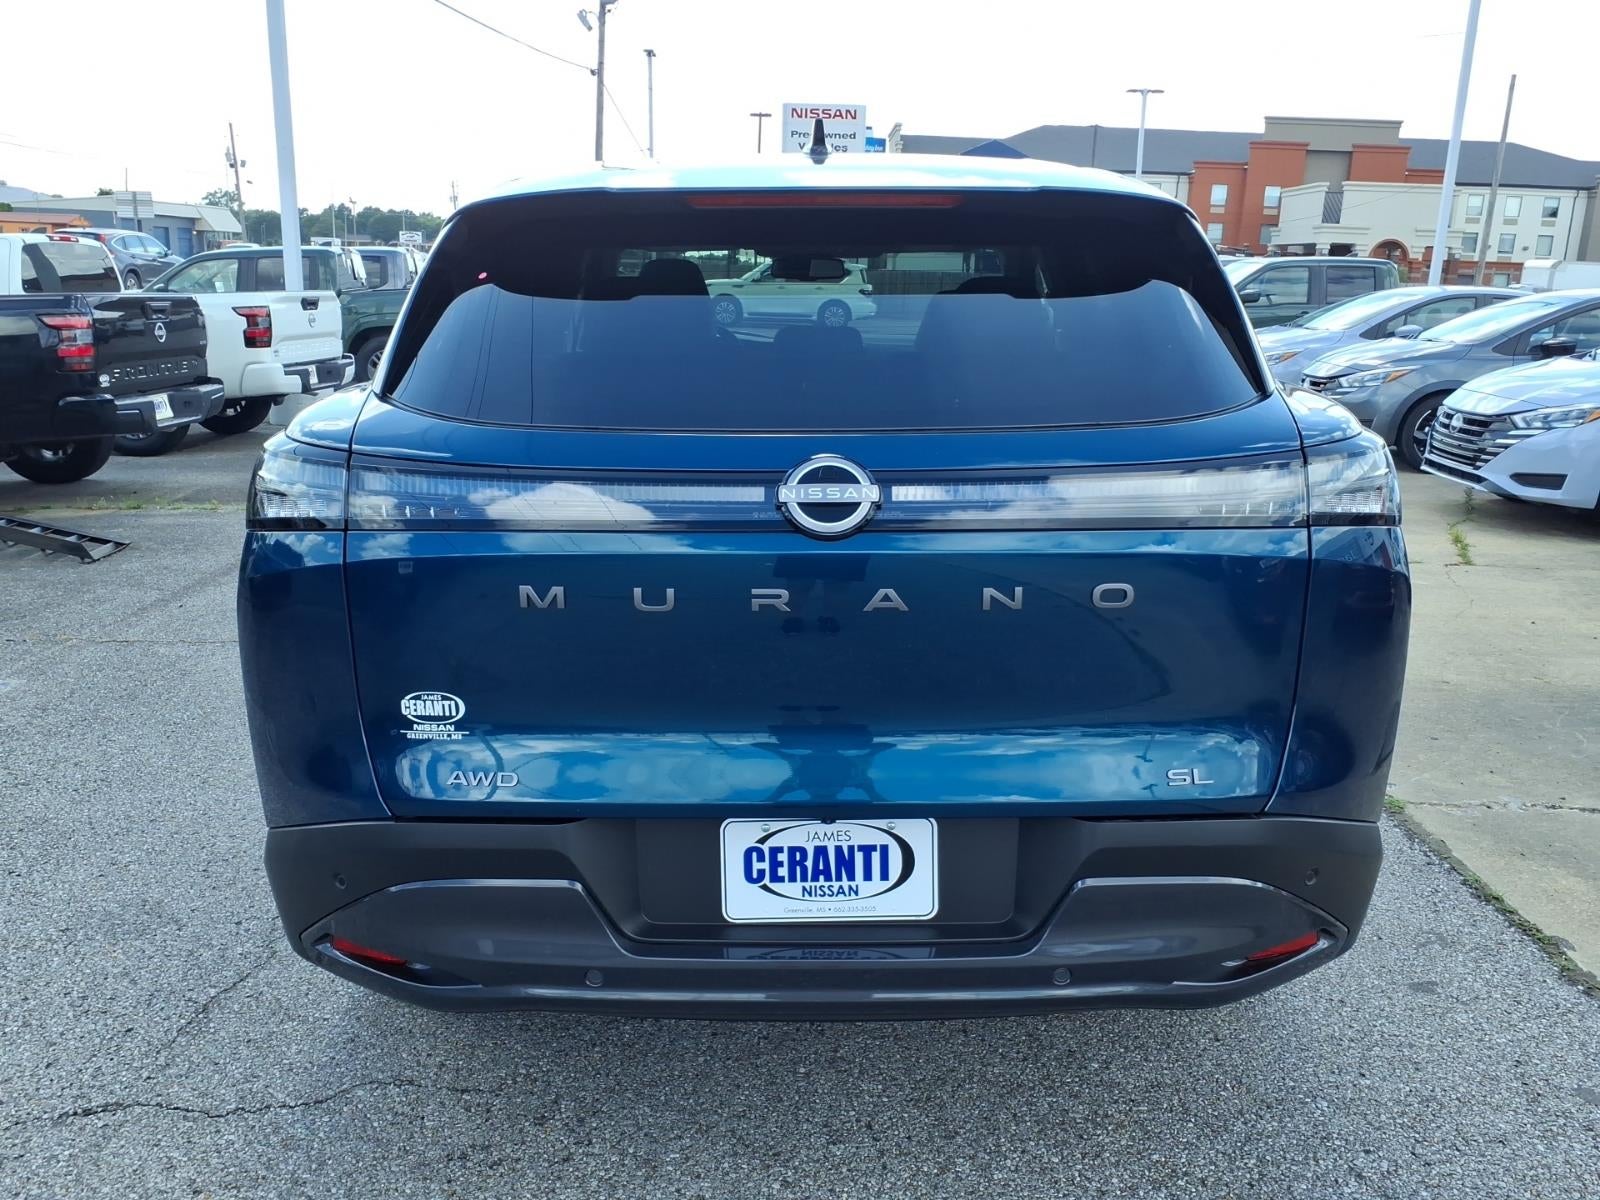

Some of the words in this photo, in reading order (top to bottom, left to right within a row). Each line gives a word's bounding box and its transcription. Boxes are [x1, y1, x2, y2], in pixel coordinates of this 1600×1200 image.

[791, 107, 857, 120] NISSAN
[781, 487, 876, 499] NISSAN
[518, 582, 1136, 613] MURANO
[400, 699, 457, 717] CERANTI
[413, 723, 455, 732] NISSAN
[446, 770, 520, 788] AWD
[1166, 767, 1215, 787] SL
[804, 830, 852, 843] JAMES
[743, 843, 890, 885] CERANTI
[801, 884, 859, 898] NISSAN
